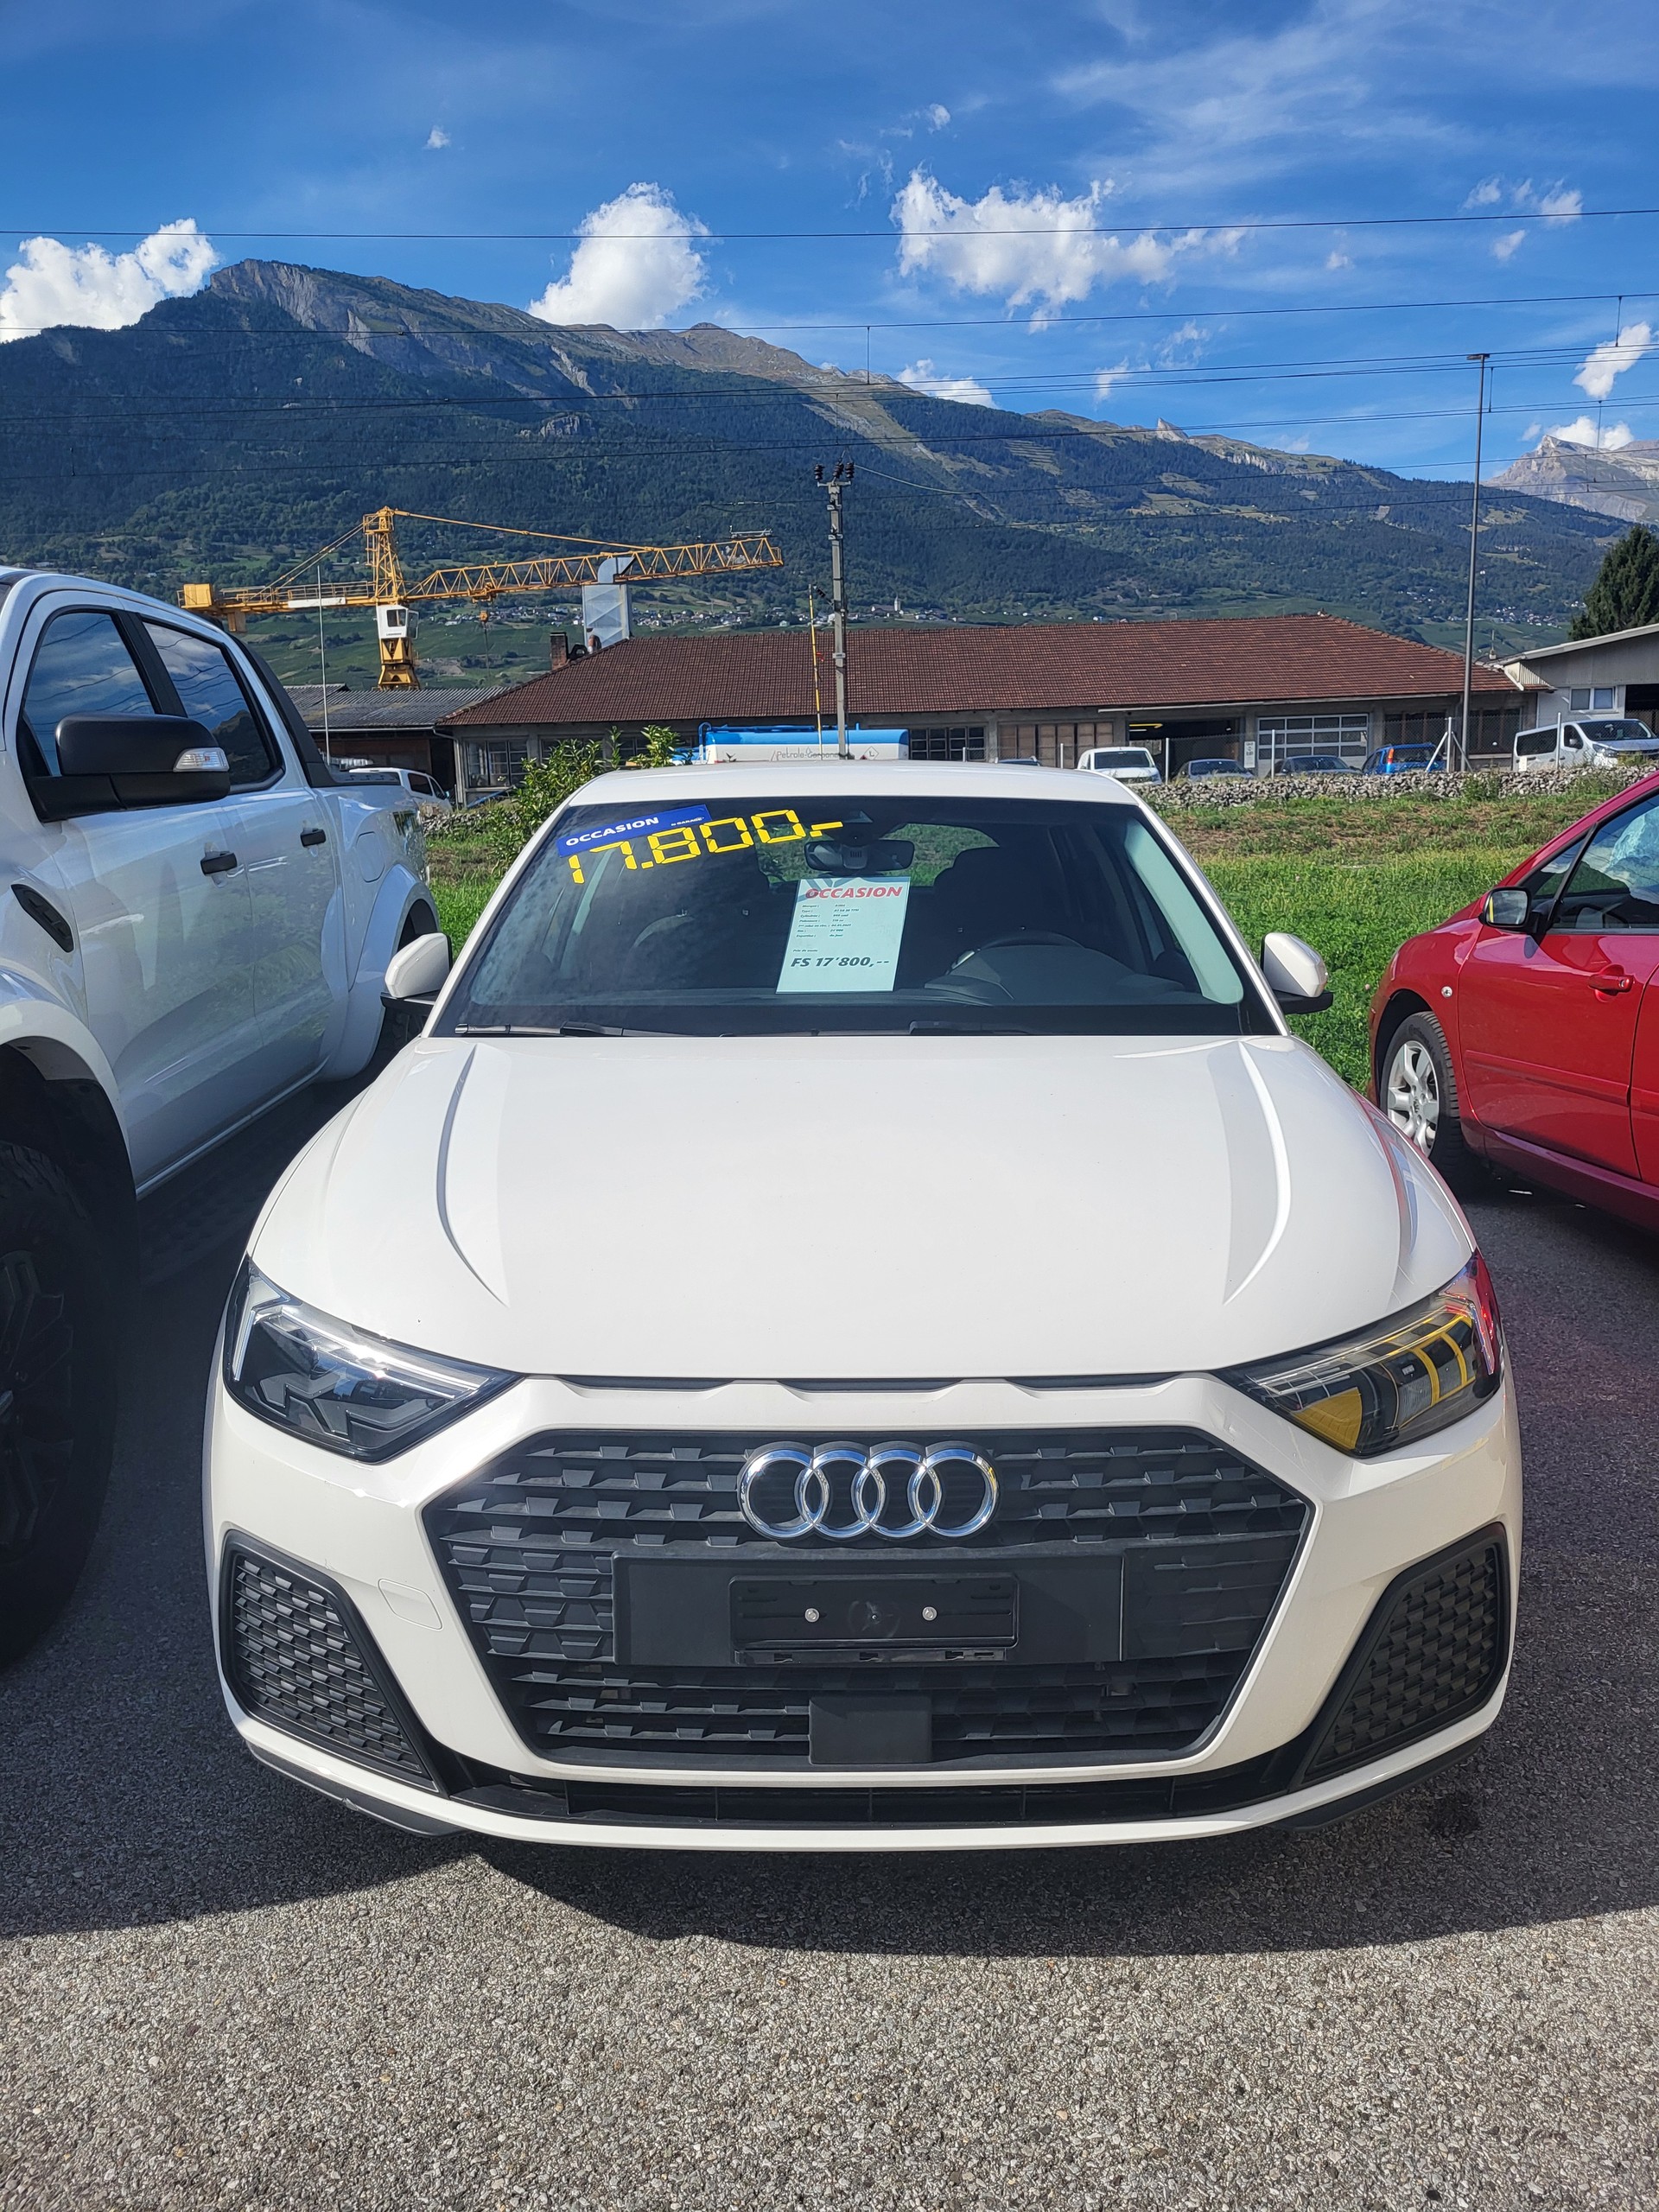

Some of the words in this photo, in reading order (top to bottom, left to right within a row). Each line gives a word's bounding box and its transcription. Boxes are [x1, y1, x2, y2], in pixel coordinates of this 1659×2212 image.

[565, 817, 659, 846] OCCASION
[804, 886, 904, 899] OCCASION
[791, 957, 811, 967] FS
